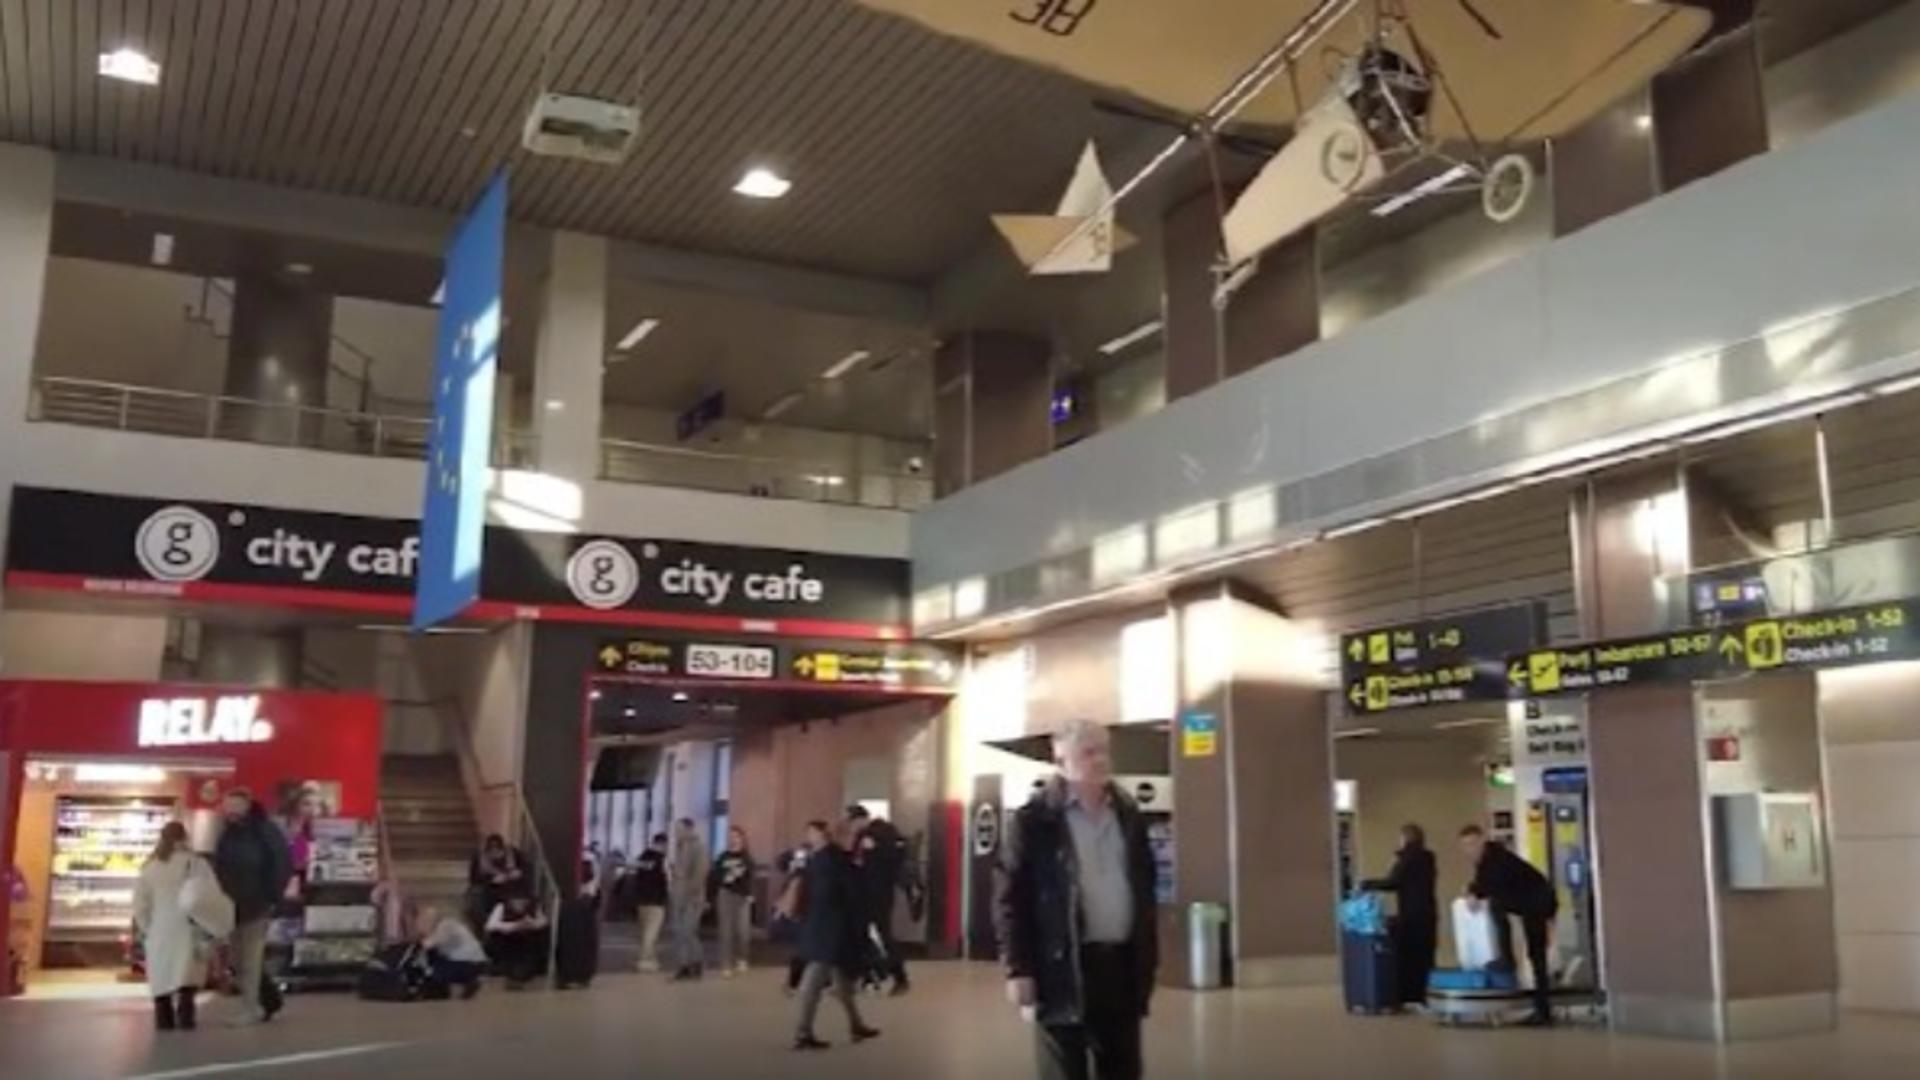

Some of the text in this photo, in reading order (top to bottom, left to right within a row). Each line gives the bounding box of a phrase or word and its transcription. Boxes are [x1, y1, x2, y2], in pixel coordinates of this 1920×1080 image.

[247, 529, 418, 580] city caf
[660, 559, 824, 605] city cafe
[688, 647, 774, 676] 53-104
